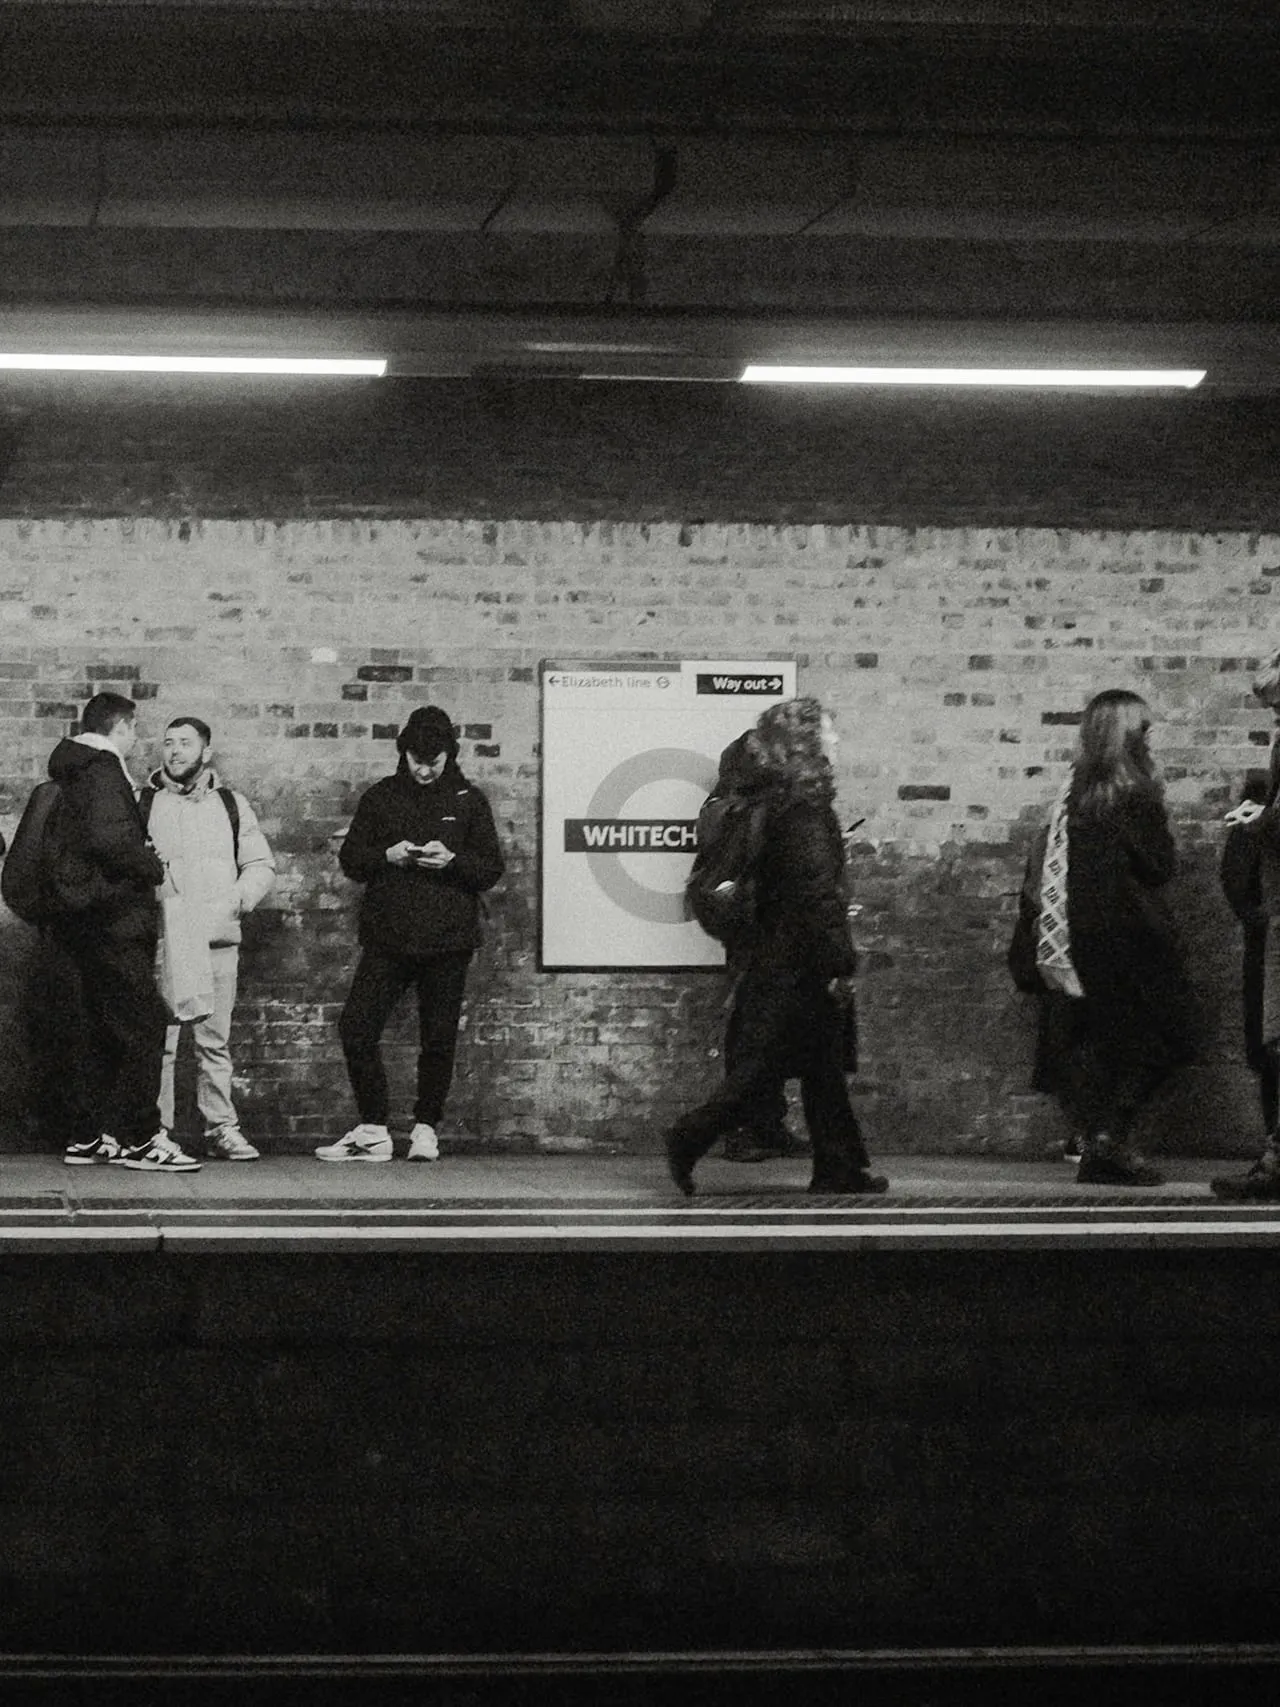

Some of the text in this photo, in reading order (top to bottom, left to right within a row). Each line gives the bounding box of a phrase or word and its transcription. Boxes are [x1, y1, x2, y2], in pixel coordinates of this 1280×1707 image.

[561, 675, 651, 689] Elizabeth line
[712, 676, 768, 692] Way out
